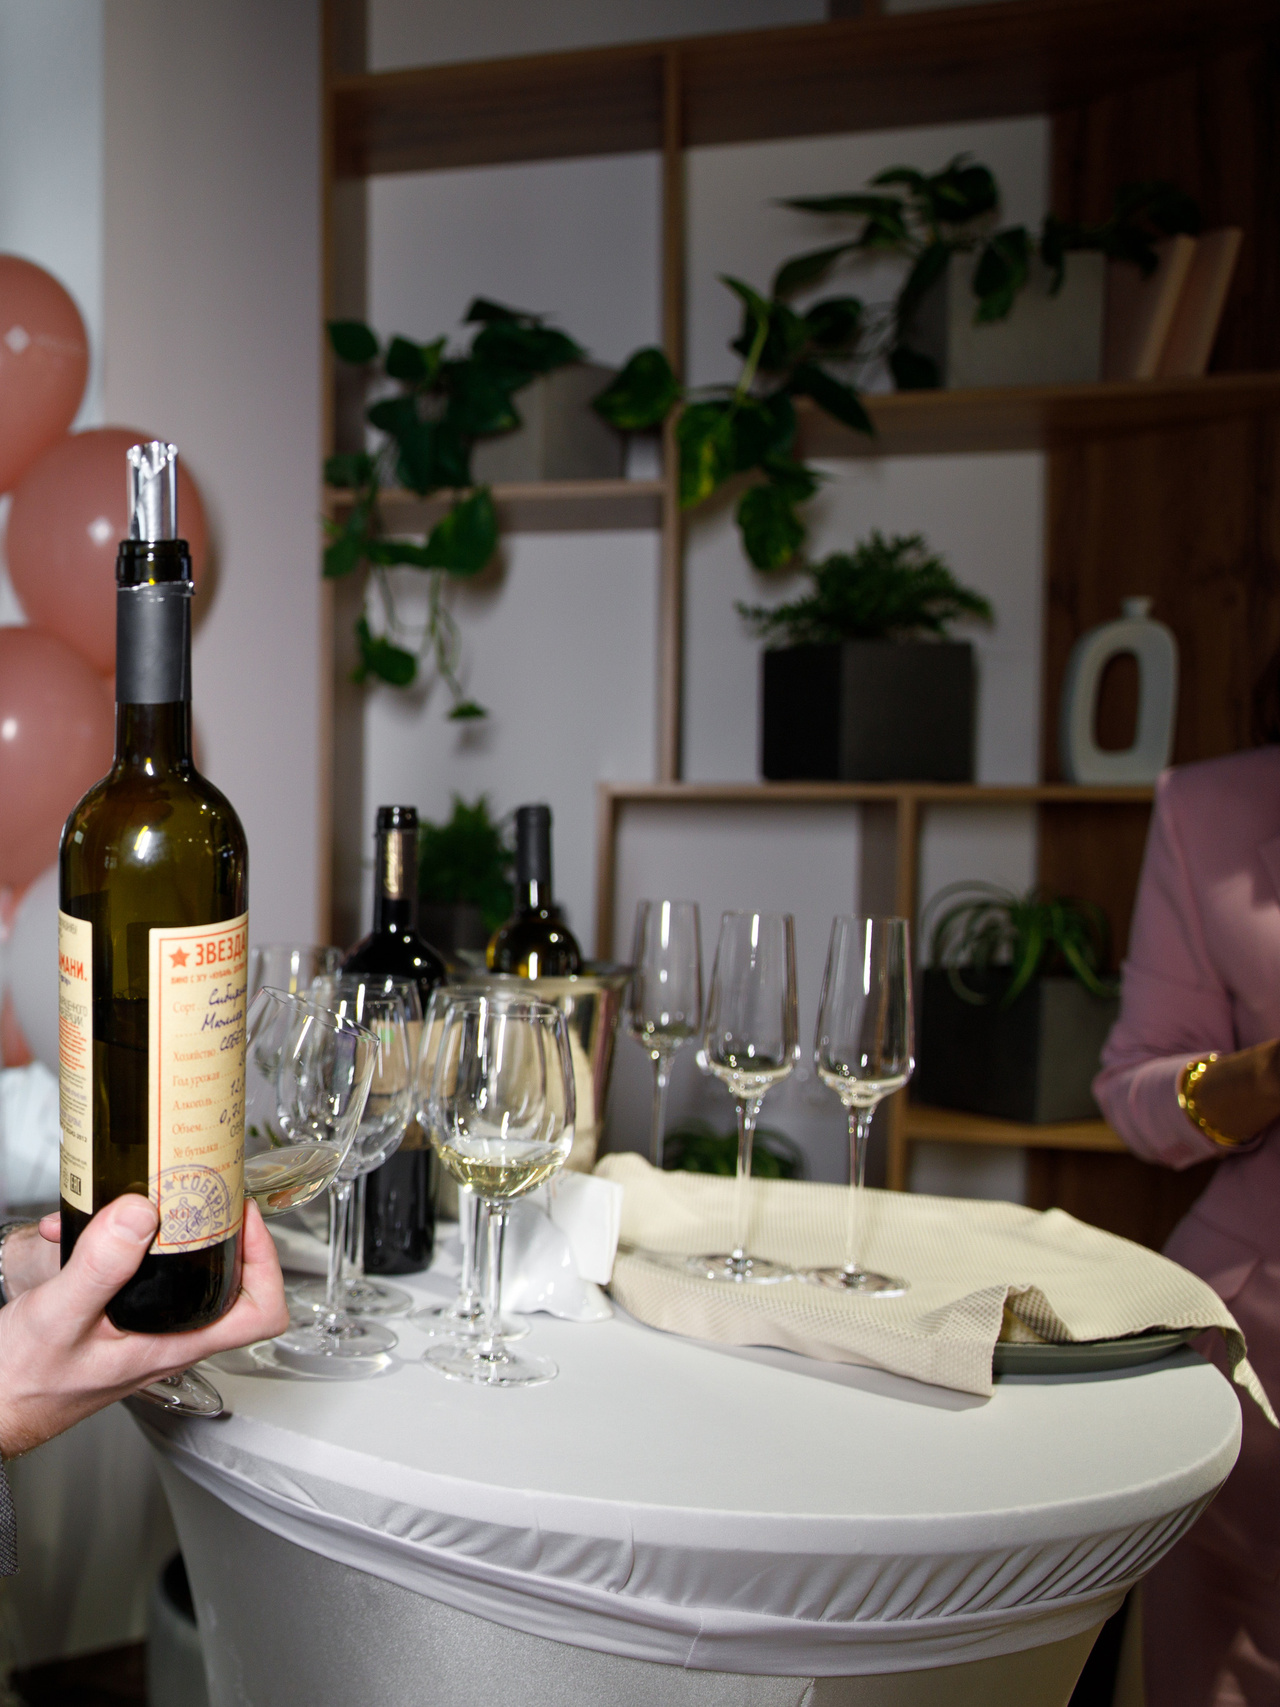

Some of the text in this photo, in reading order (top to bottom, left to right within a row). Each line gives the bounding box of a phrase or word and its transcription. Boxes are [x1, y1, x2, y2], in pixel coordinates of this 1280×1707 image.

[173, 1075, 189, 1087] Год
[173, 1098, 212, 1111] Алкоголь
[185, 1143, 219, 1161] бутылки
